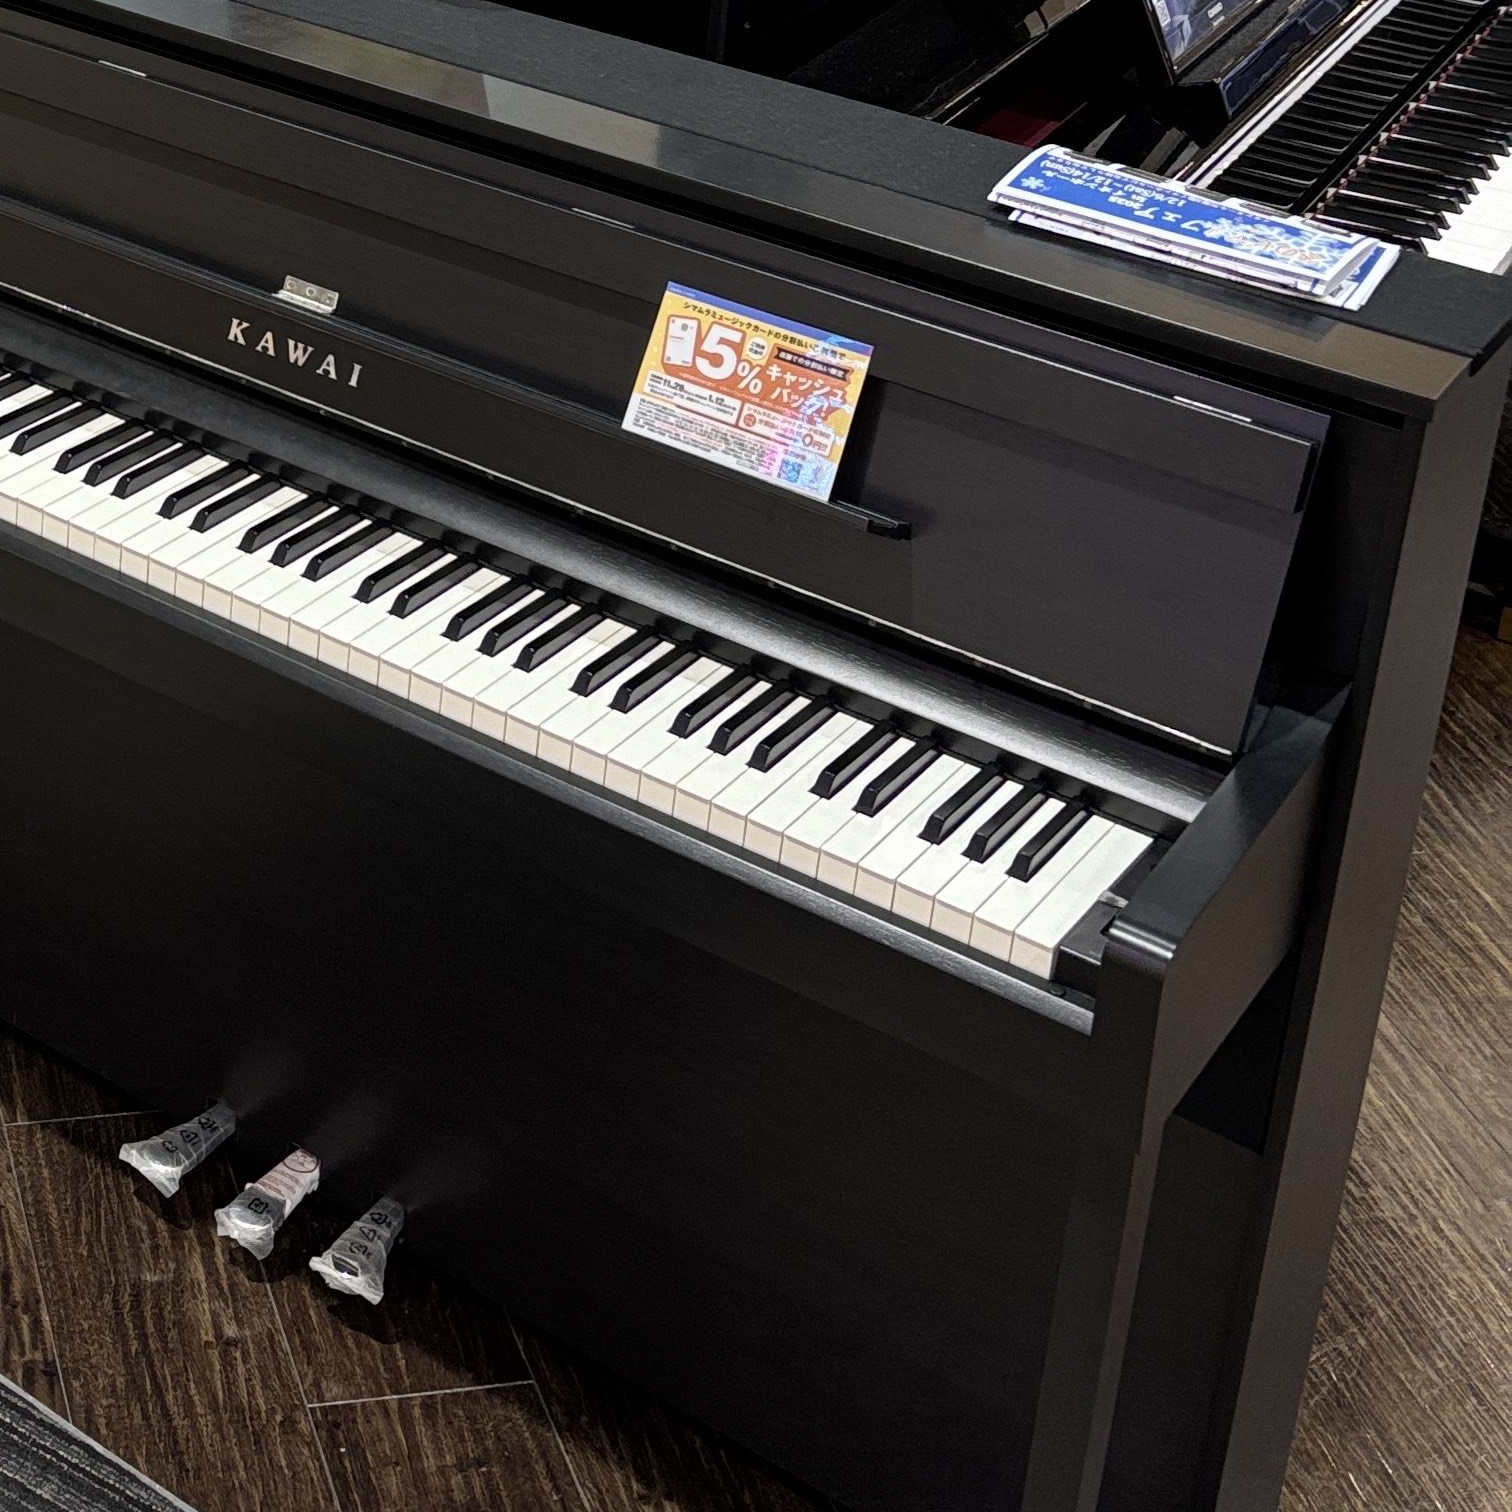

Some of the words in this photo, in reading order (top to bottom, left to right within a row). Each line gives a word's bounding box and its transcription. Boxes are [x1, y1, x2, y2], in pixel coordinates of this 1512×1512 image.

[226, 316, 363, 389] KAWAI
[764, 363, 846, 402] キャッシュ
[770, 386, 830, 418] バック!
